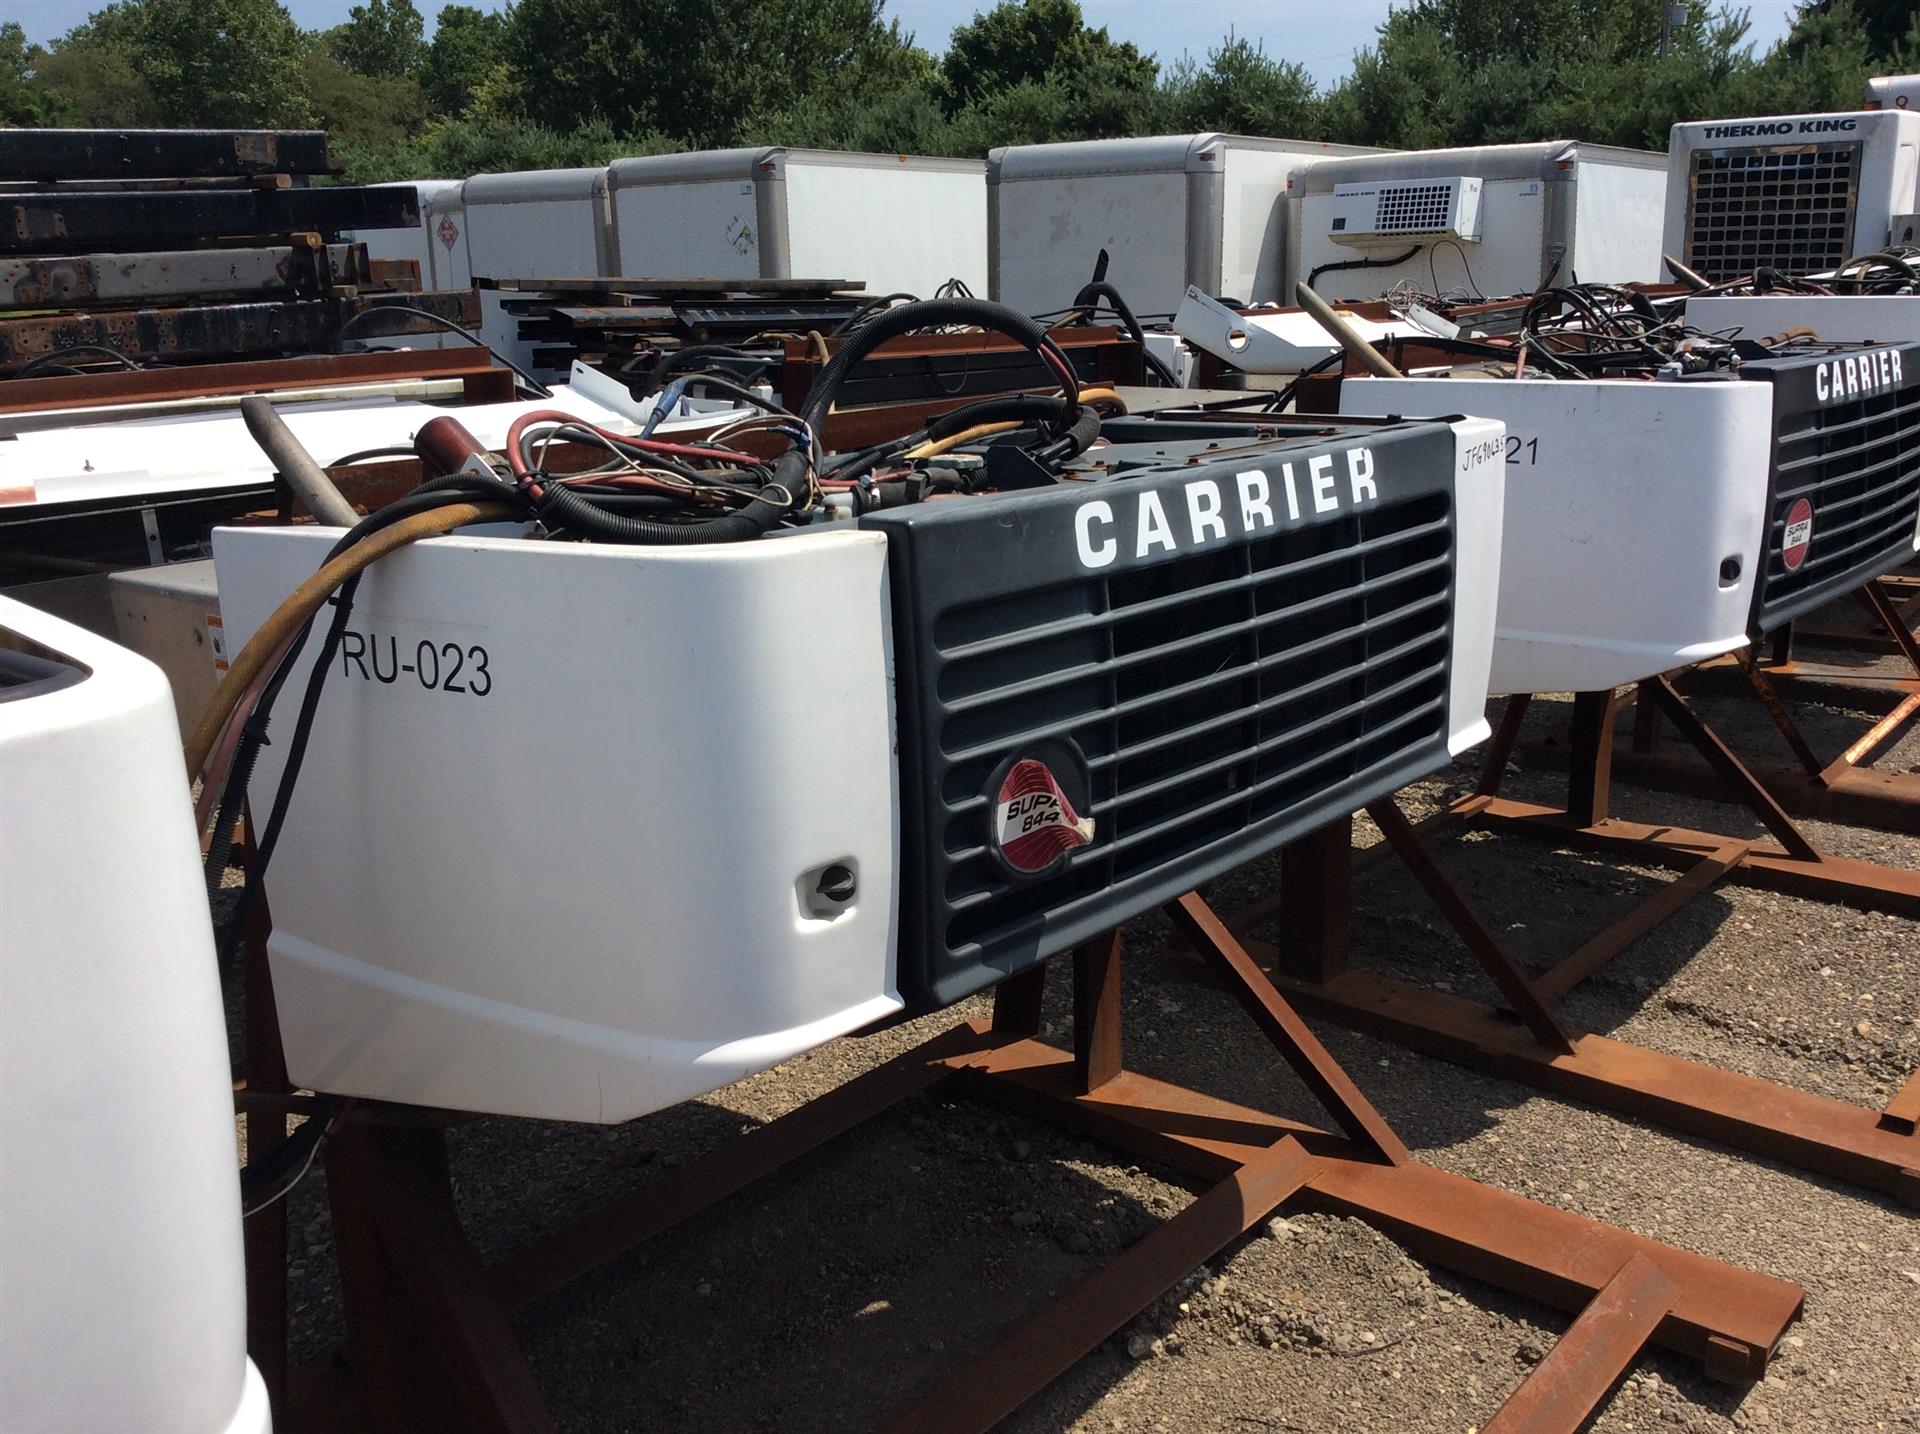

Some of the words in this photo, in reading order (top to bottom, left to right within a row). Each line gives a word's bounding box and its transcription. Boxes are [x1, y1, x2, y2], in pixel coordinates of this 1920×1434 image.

[1704, 122, 1793, 139] THERMO
[1799, 119, 1857, 134] KING
[1816, 349, 1903, 401] CARRIER
[1074, 447, 1378, 569] CARRIER
[341, 630, 492, 697] RU-023
[1007, 794, 1060, 821] SUP
[1021, 811, 1061, 833] 844
